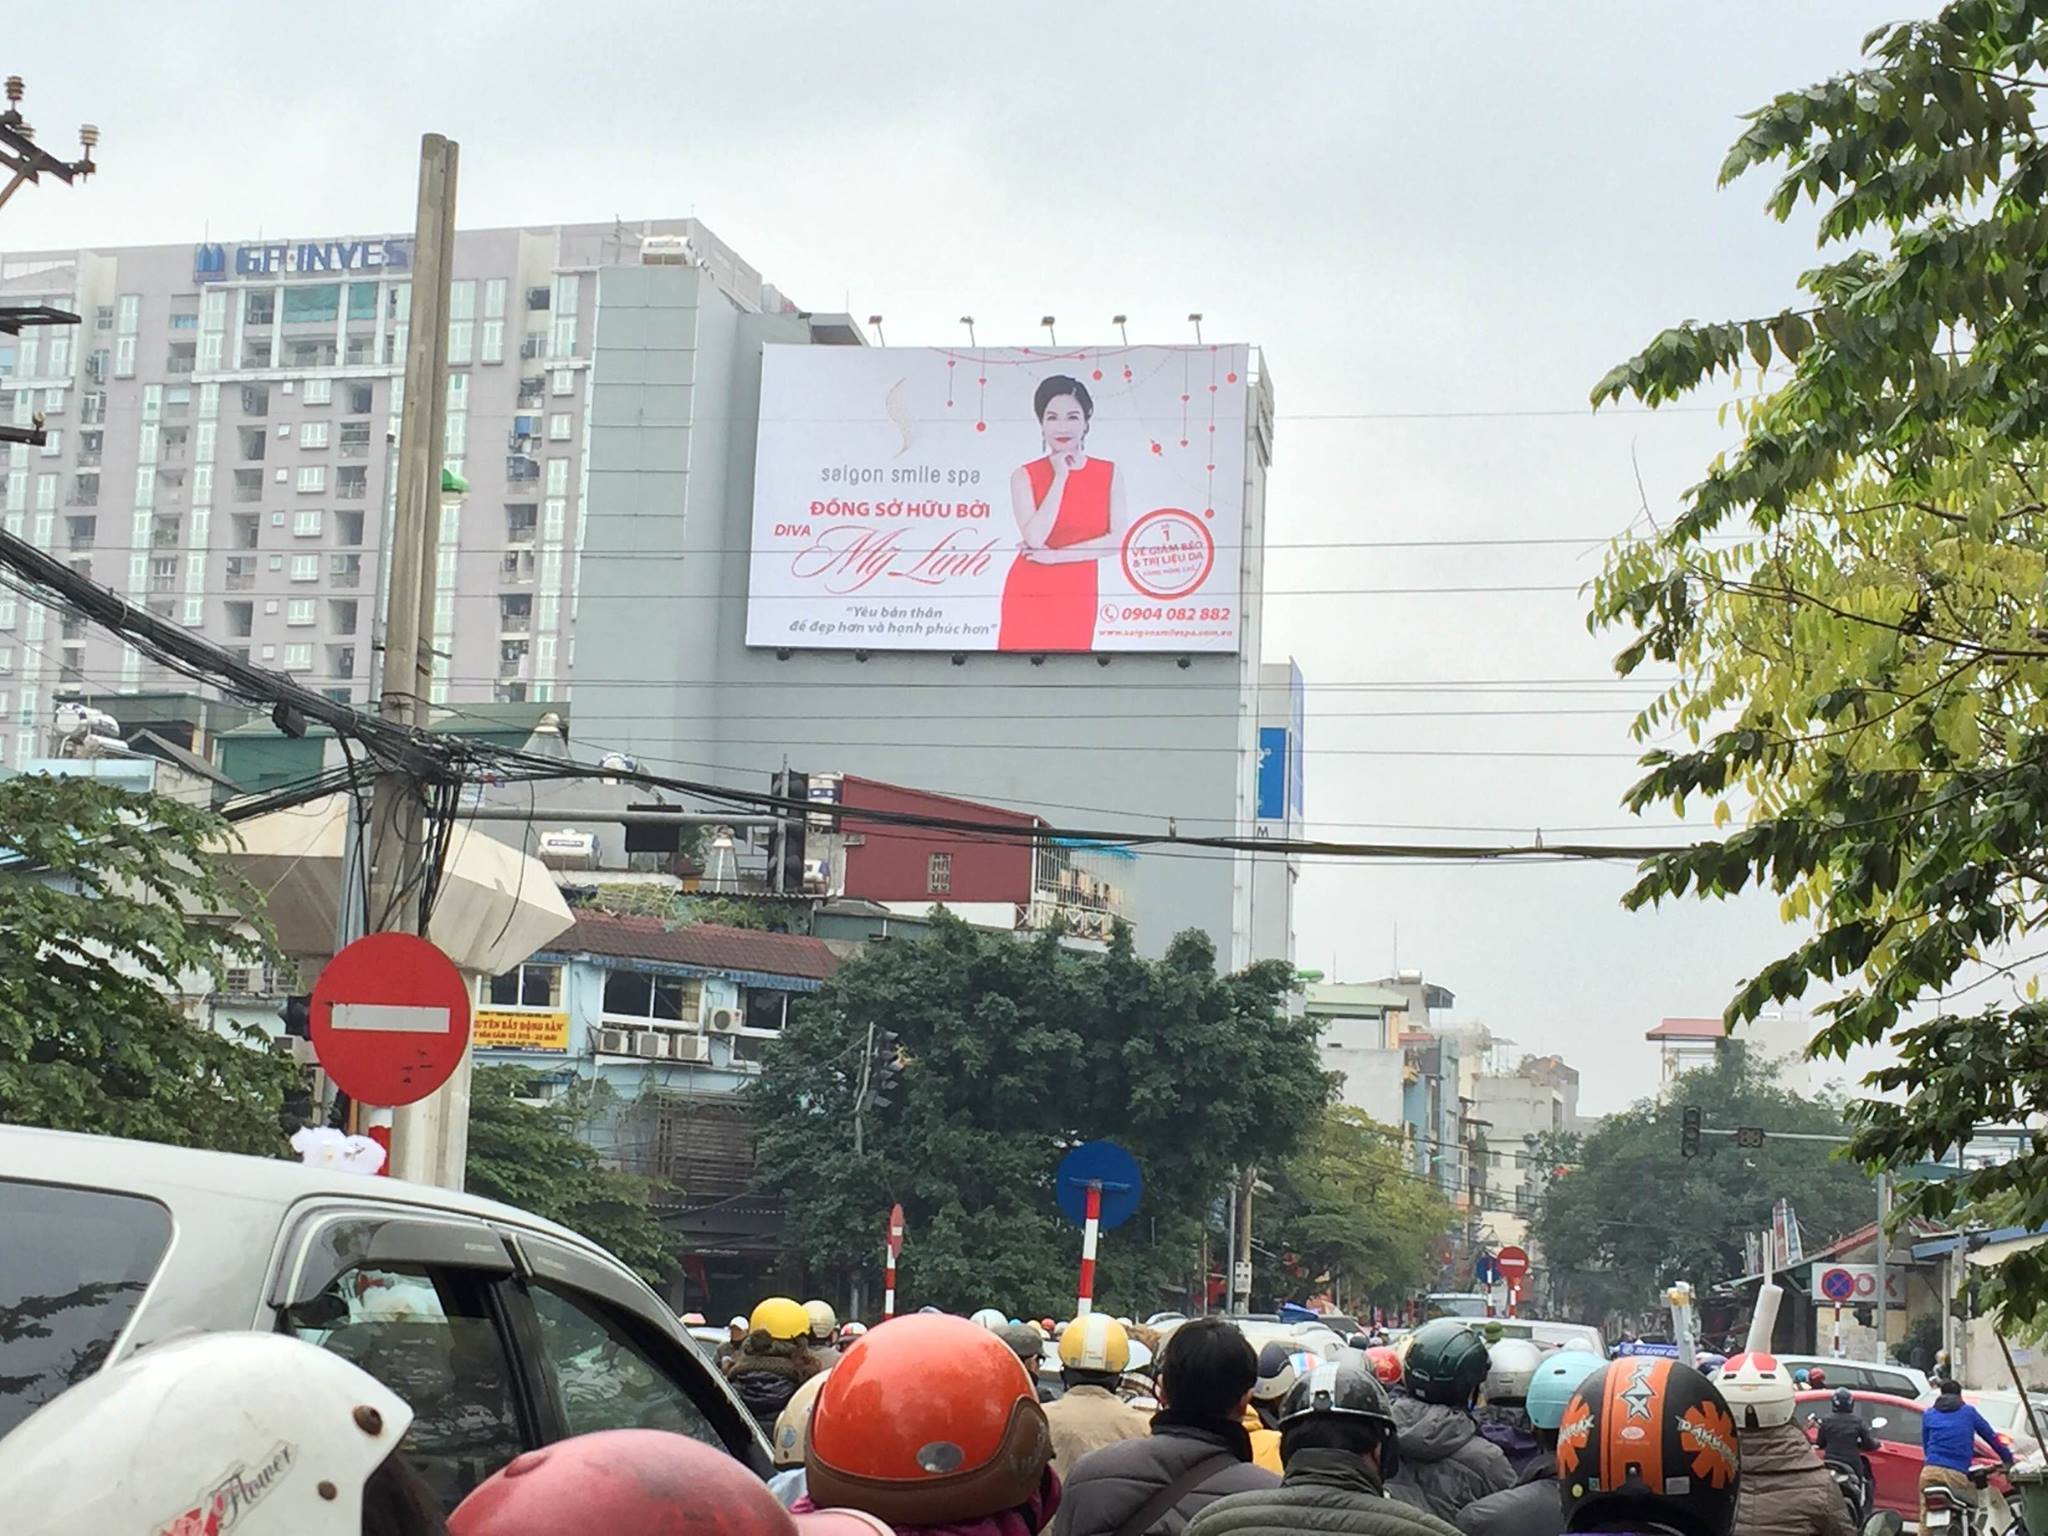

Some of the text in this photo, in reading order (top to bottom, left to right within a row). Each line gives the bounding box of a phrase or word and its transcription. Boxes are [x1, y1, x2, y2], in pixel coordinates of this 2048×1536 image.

[821, 465, 981, 487] saigon smile spa
[874, 498, 904, 518] SỞ
[907, 500, 951, 518] HỮU
[774, 524, 811, 537] DIVA
[1162, 530, 1170, 541] 1
[911, 607, 943, 619] thân
[1122, 607, 1231, 621] 0904 082 882
[809, 620, 835, 635] đẹp
[868, 622, 884, 634] và
[886, 621, 924, 636] hạnh
[926, 621, 960, 637] phúc
